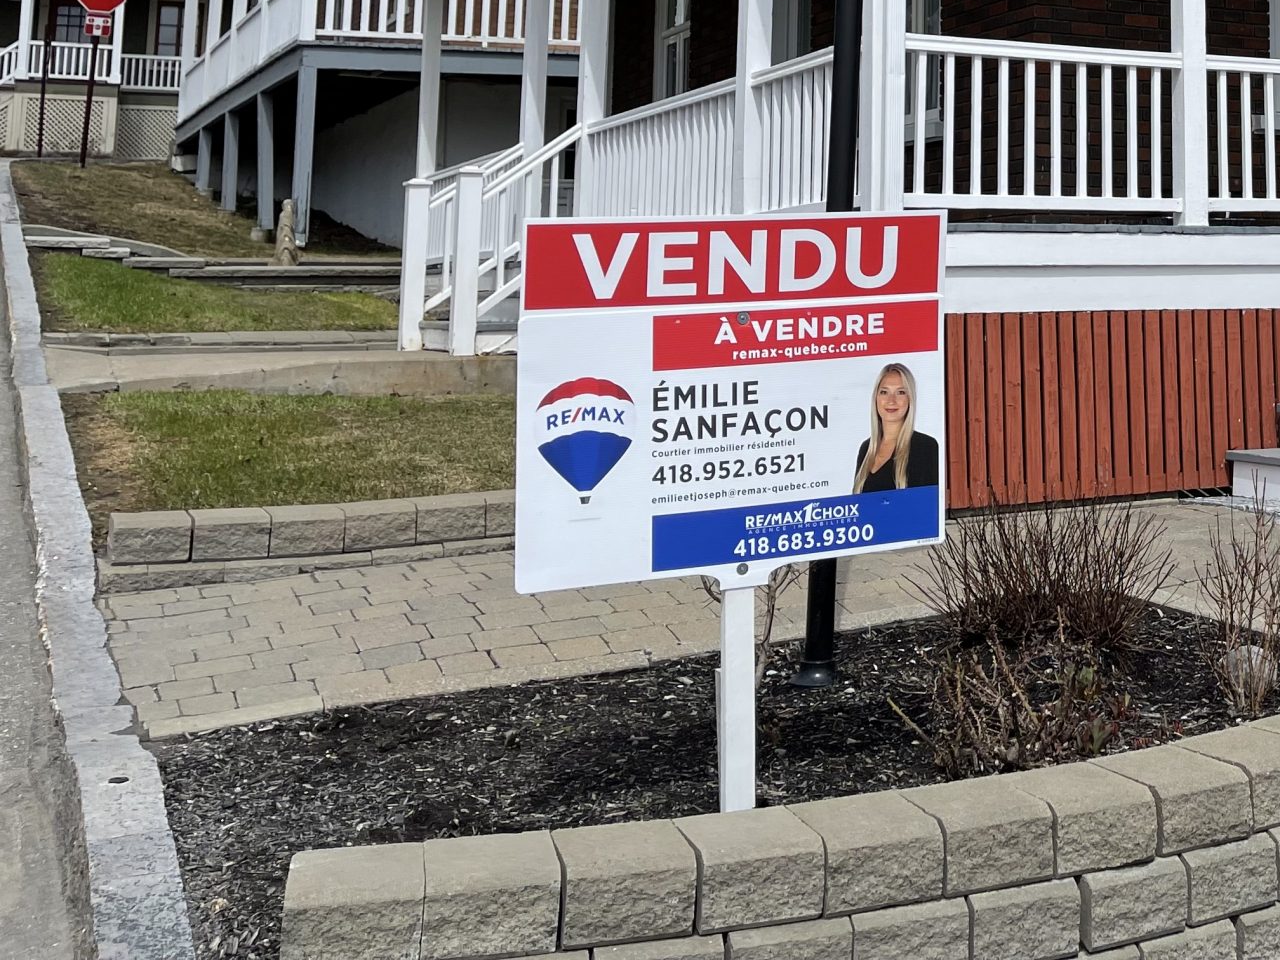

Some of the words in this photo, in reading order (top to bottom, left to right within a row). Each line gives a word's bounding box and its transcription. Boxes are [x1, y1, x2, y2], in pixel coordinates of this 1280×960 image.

[571, 226, 899, 300] VENDU
[714, 316, 738, 345] À
[751, 312, 885, 342] VENDRE
[732, 341, 868, 360] remax-quebec.com
[652, 379, 759, 412] ÉMILIE
[546, 406, 625, 431] RE/MAX
[651, 405, 829, 443] SANFAÇON
[652, 446, 691, 458] Courtier
[694, 443, 745, 455] immobilier
[747, 439, 796, 450] résidentiel
[651, 453, 806, 485] 418.952.6521
[651, 480, 830, 504] emilieetjoseph@remax-quebec.com
[733, 523, 875, 557] 418.683.9300
[748, 526, 787, 535] AGENCE
